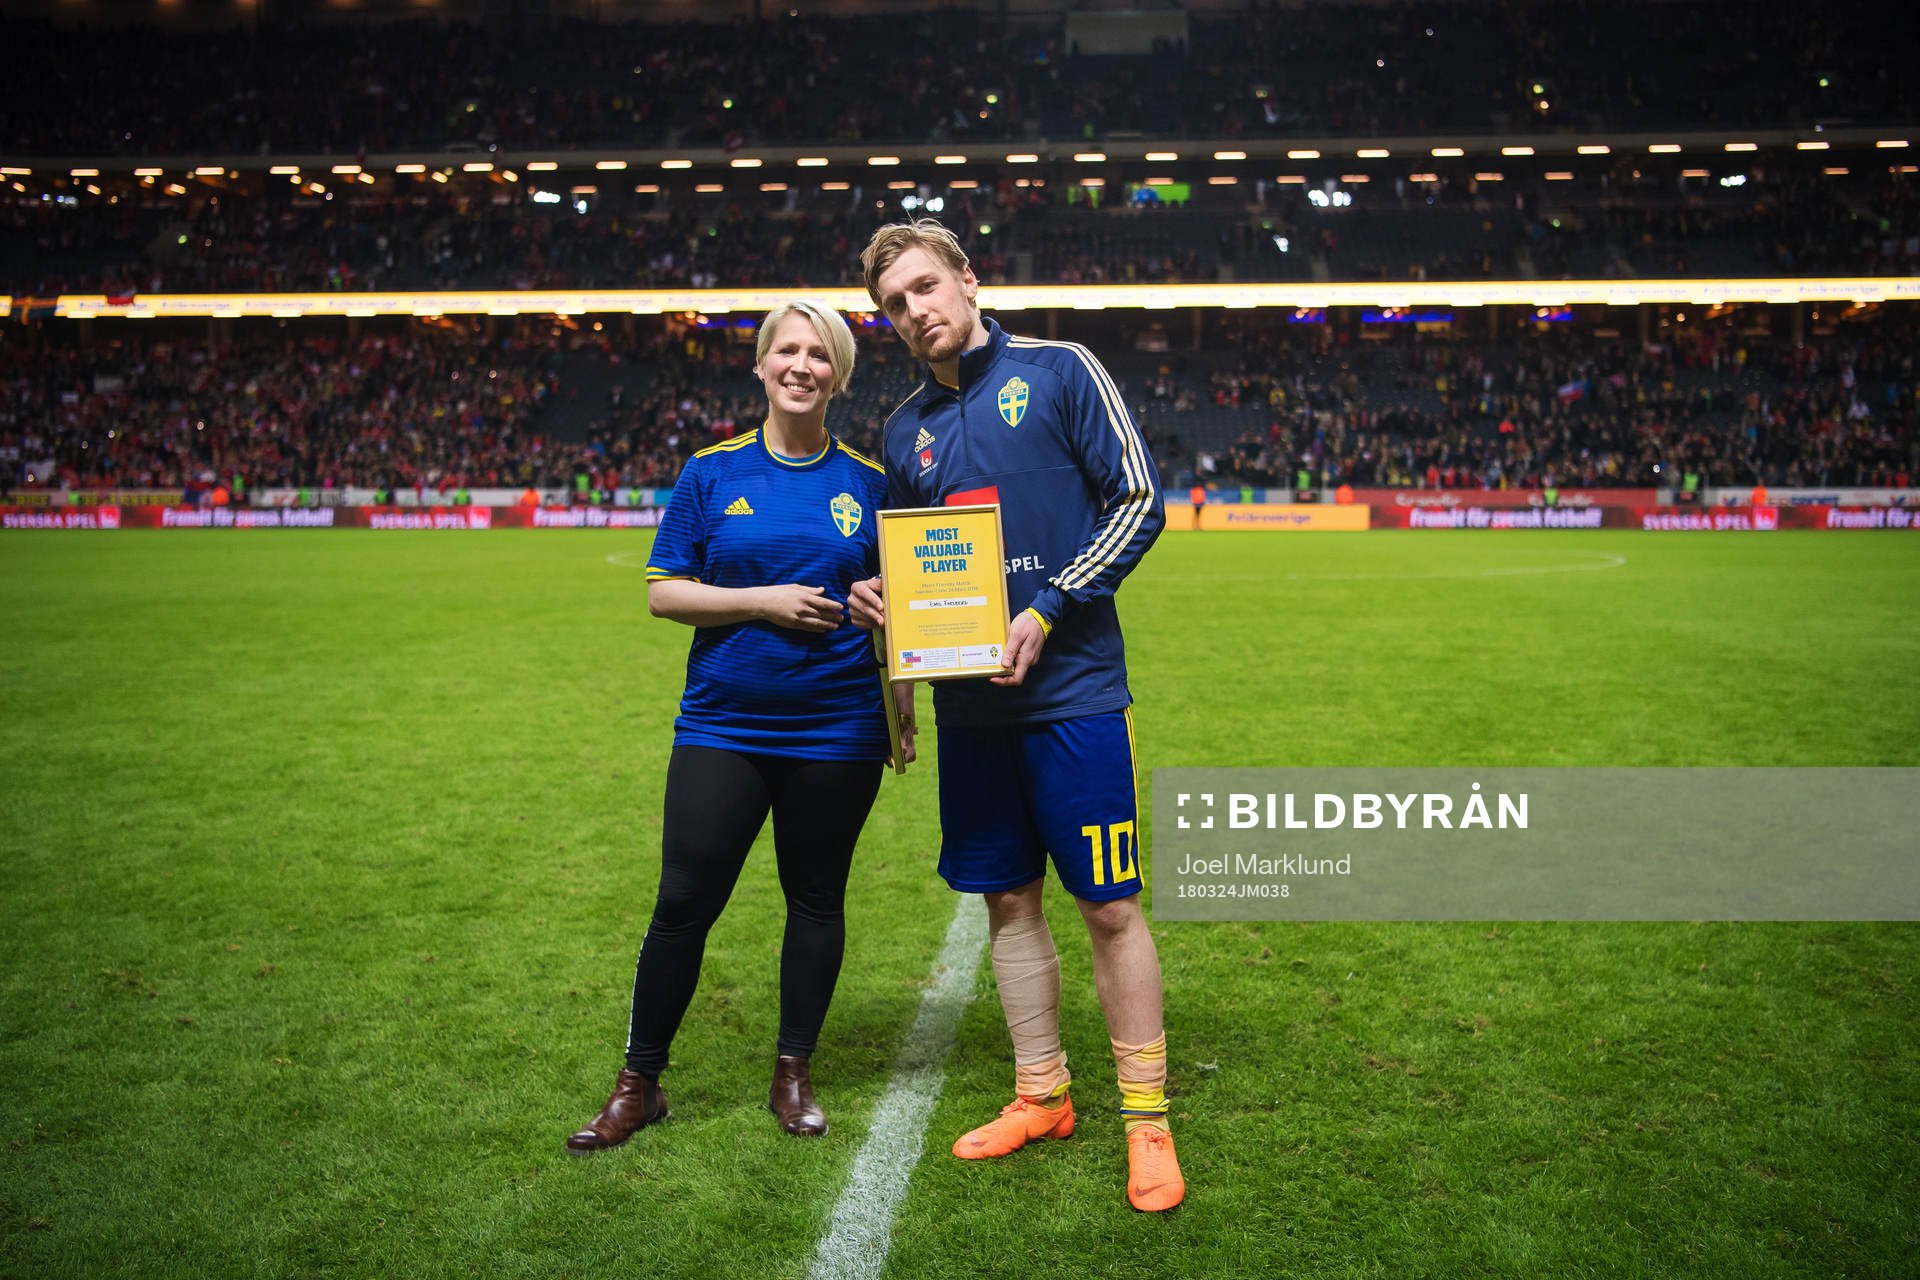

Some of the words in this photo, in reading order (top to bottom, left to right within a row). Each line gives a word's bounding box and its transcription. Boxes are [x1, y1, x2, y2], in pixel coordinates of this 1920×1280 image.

[914, 435, 936, 453] adidas
[724, 508, 754, 516] adidas
[1643, 514, 1711, 530] SVENSKA
[1715, 513, 1750, 529] SPEL
[925, 527, 959, 542] MOST
[913, 542, 973, 558] VALUABLE
[922, 558, 967, 574] PLAYER
[1082, 820, 1137, 886] 10
